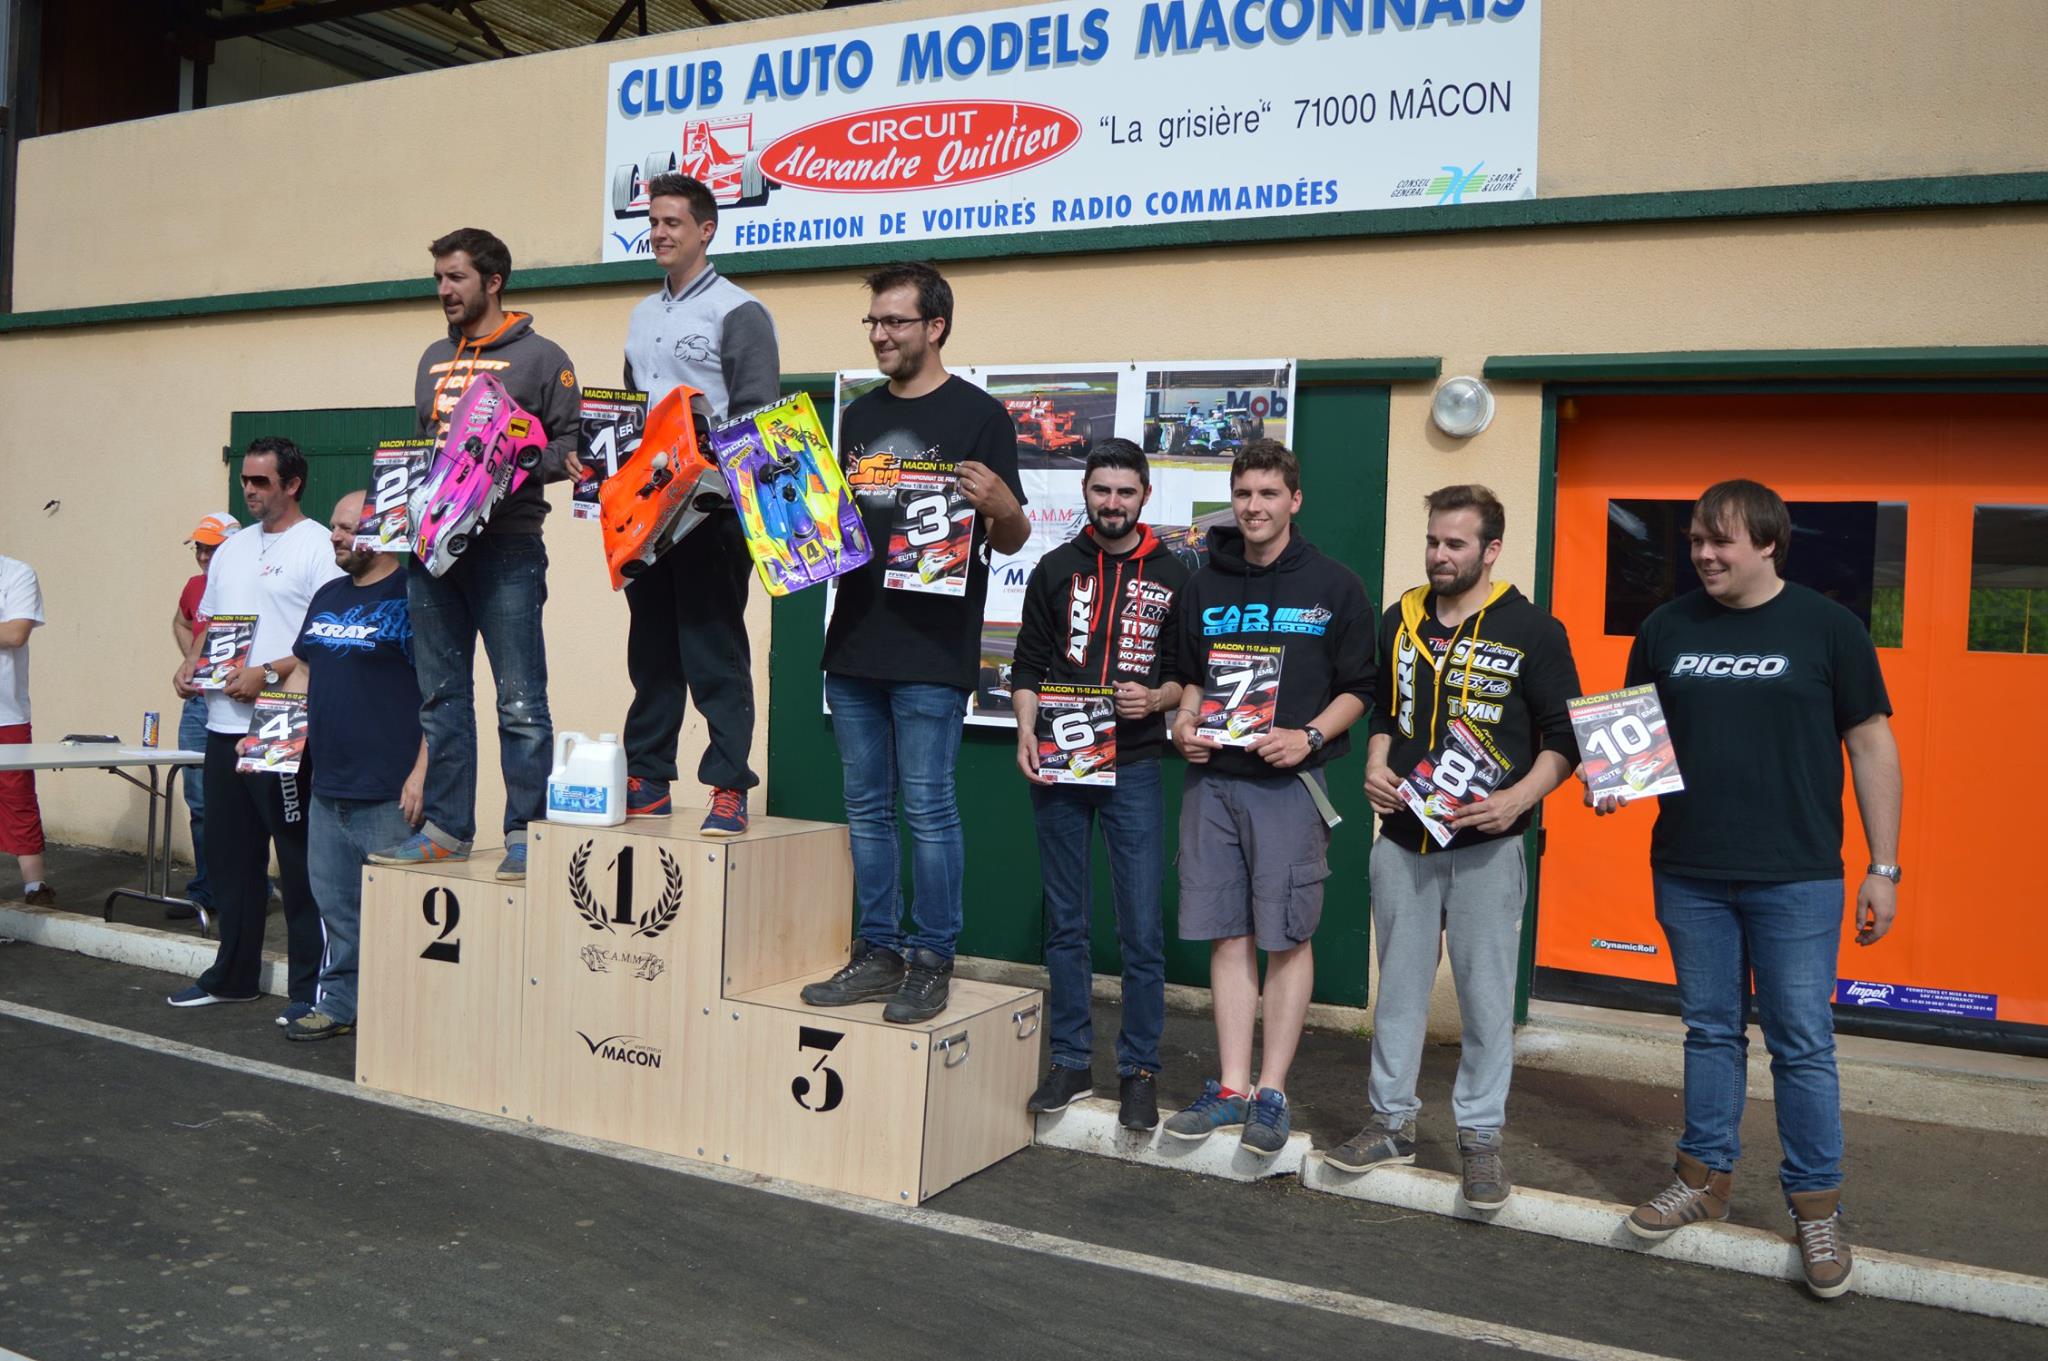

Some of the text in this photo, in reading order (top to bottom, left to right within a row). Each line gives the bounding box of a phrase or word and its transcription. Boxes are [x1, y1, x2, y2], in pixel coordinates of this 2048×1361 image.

[620, 59, 723, 116] CLUB
[746, 39, 873, 101] AUTO
[898, 9, 1109, 83] MODELS
[1295, 92, 1376, 129] 71000
[1390, 79, 1511, 120] MÂCON
[847, 110, 977, 146] CIRCUIT
[775, 121, 1060, 182] Alexandre Quillien
[1397, 179, 1431, 189] CONSEIL
[736, 178, 1338, 247] FÉDÉRATION DE VOITURES RADIO COMMANDÉES
[584, 390, 613, 399] MACON
[614, 391, 627, 400] 11-12
[380, 440, 405, 448] MACON
[589, 423, 634, 478] 1 ER
[900, 473, 937, 481] CHAMPIONNAT
[902, 461, 953, 472] MACON 11-12
[376, 467, 408, 514] 2
[582, 482, 599, 493] ELITE
[906, 494, 967, 547] 3 EM
[898, 551, 918, 561] ELITE
[1067, 575, 1094, 665] ARC
[1125, 601, 1168, 621] ART
[1202, 603, 1270, 626] CAR
[305, 622, 379, 639] XRAY
[209, 633, 236, 664] 5
[1213, 643, 1245, 651] MACON
[1672, 654, 1787, 677] PICCO
[260, 691, 286, 699] MACON
[1041, 685, 1075, 693] MACON
[1216, 669, 1254, 711] 7
[1398, 634, 1417, 735] ARC
[1570, 694, 1609, 708] MACON
[259, 712, 292, 741] 4
[1052, 712, 1095, 751] 6
[1461, 714, 1486, 742] MACON
[1585, 715, 1652, 765] 10
[1047, 754, 1069, 763] ELITE
[1432, 749, 1476, 798] 8
[607, 846, 637, 925] 1
[419, 886, 461, 964] 2
[1600, 940, 1655, 952] DynamicRoll
[1935, 995, 1974, 1003] MAINTENANCE
[602, 1045, 661, 1069] MACON
[791, 1025, 846, 1112] 3
